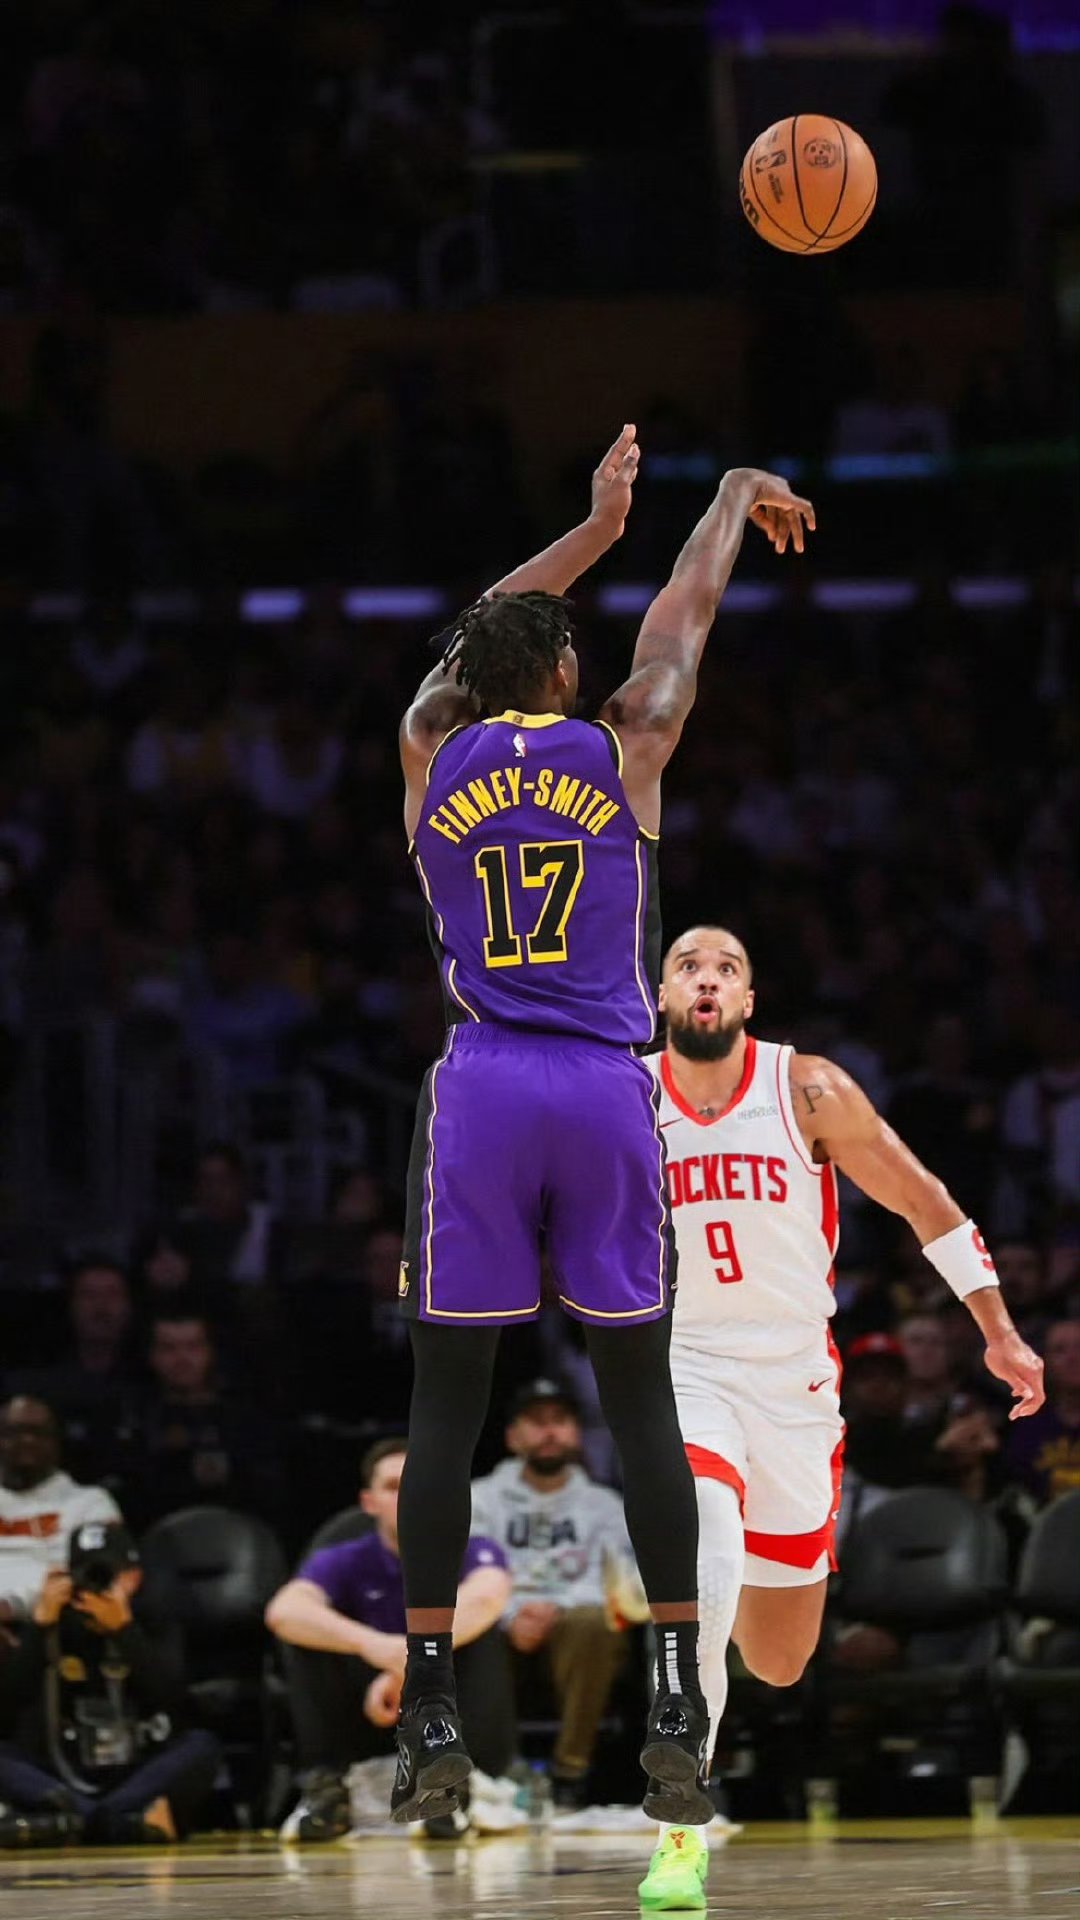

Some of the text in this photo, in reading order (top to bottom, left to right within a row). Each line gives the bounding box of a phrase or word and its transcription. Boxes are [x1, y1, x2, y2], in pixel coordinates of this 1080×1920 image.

[428, 767, 620, 844] FINNEY-SMITH
[474, 840, 584, 968] 17
[665, 1153, 788, 1208] OCKETS
[705, 1221, 743, 1284] 9
[507, 1513, 577, 1549] USA
